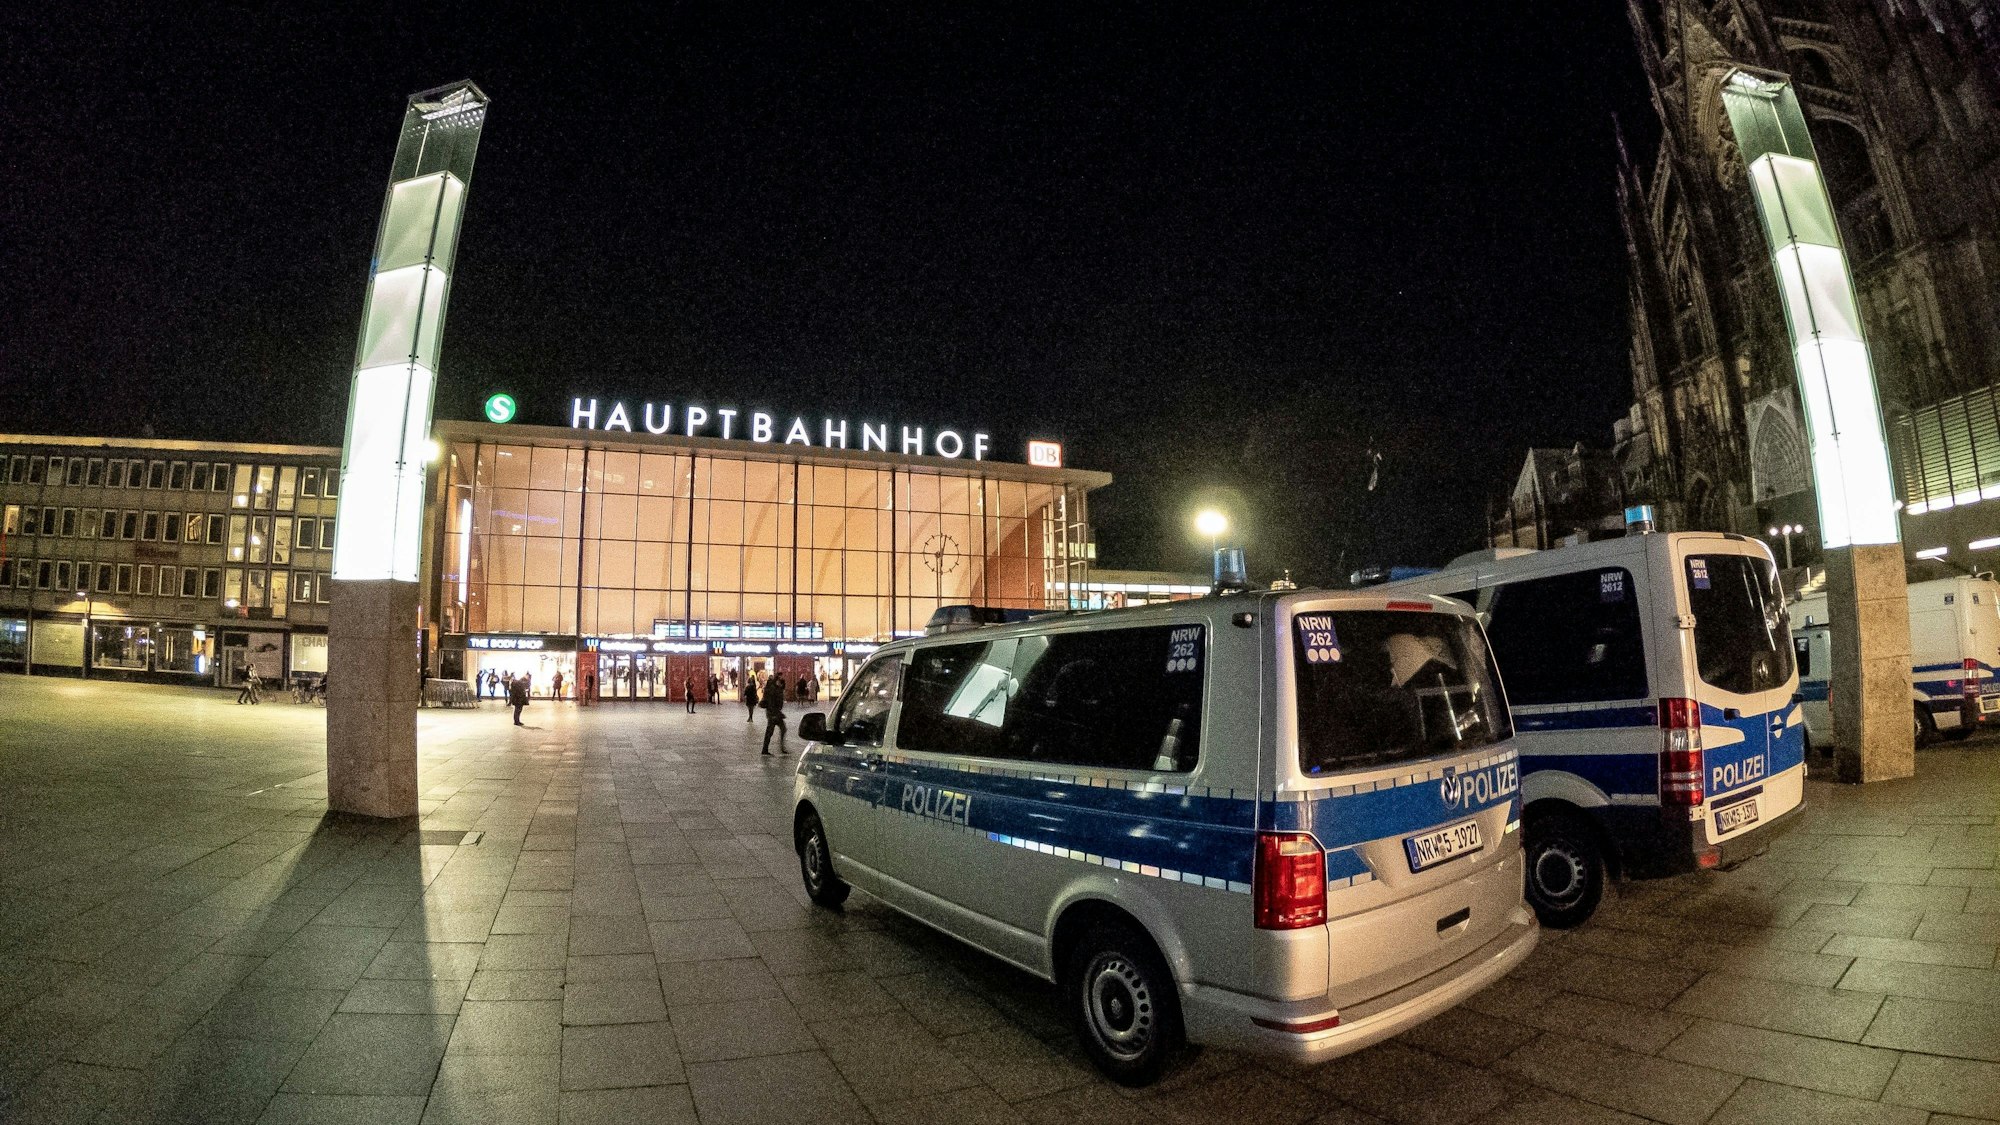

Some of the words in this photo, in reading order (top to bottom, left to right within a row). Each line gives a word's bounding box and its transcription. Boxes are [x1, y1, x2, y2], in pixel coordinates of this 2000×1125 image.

[489, 397, 511, 421] S
[572, 397, 989, 461] HAUPTBAHNHOF
[1033, 444, 1059, 464] DB
[1690, 559, 1706, 569] NRW
[1600, 571, 1623, 583] NRW
[1693, 569, 1708, 579] 2612
[1602, 581, 1623, 593] 2612
[1299, 616, 1332, 631] NRW
[470, 638, 488, 648] THE
[490, 639, 516, 648] BODY
[518, 640, 543, 649] SHOP
[1170, 627, 1200, 644] NRW
[1309, 632, 1333, 646] 262
[1173, 643, 1194, 658] 262
[1713, 754, 1764, 791] POLIZEI
[1463, 762, 1519, 808] POLIZEI
[901, 783, 972, 825] POLIZEI
[1416, 835, 1440, 862] NRW
